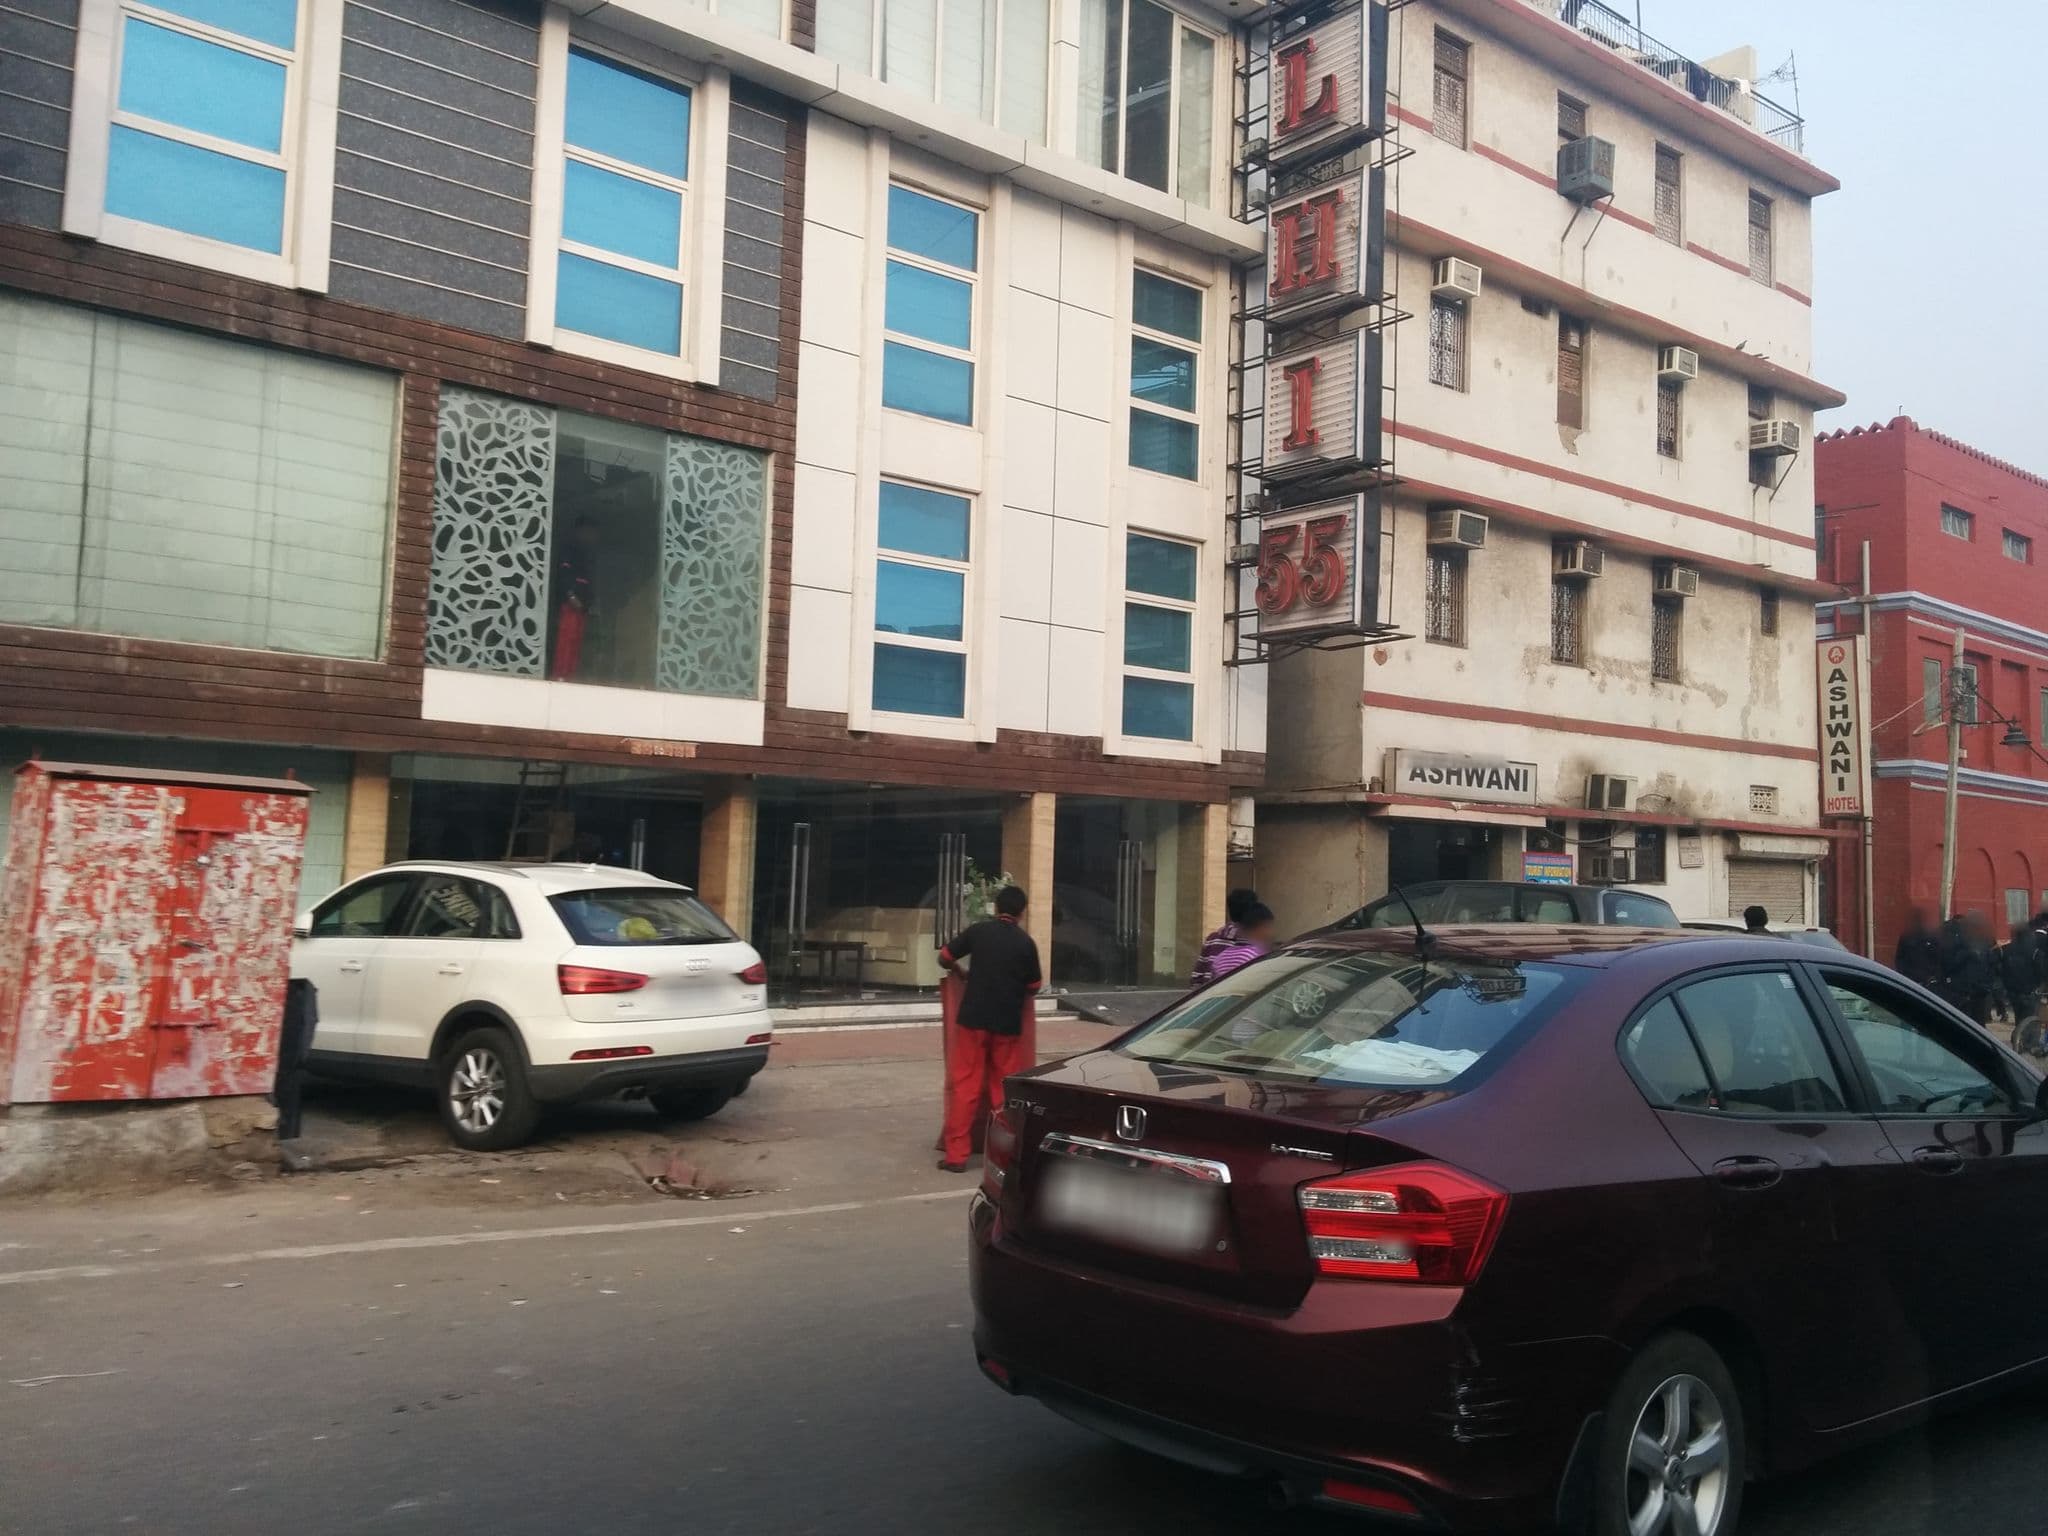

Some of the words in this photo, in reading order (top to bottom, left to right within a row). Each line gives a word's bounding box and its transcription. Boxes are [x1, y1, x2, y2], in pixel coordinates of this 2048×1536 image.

[1254, 515, 1347, 615] 55
[1826, 667, 1853, 792] ASHWANI
[1409, 765, 1528, 792] ASHWANI
[1827, 797, 1859, 812] HOTEL
